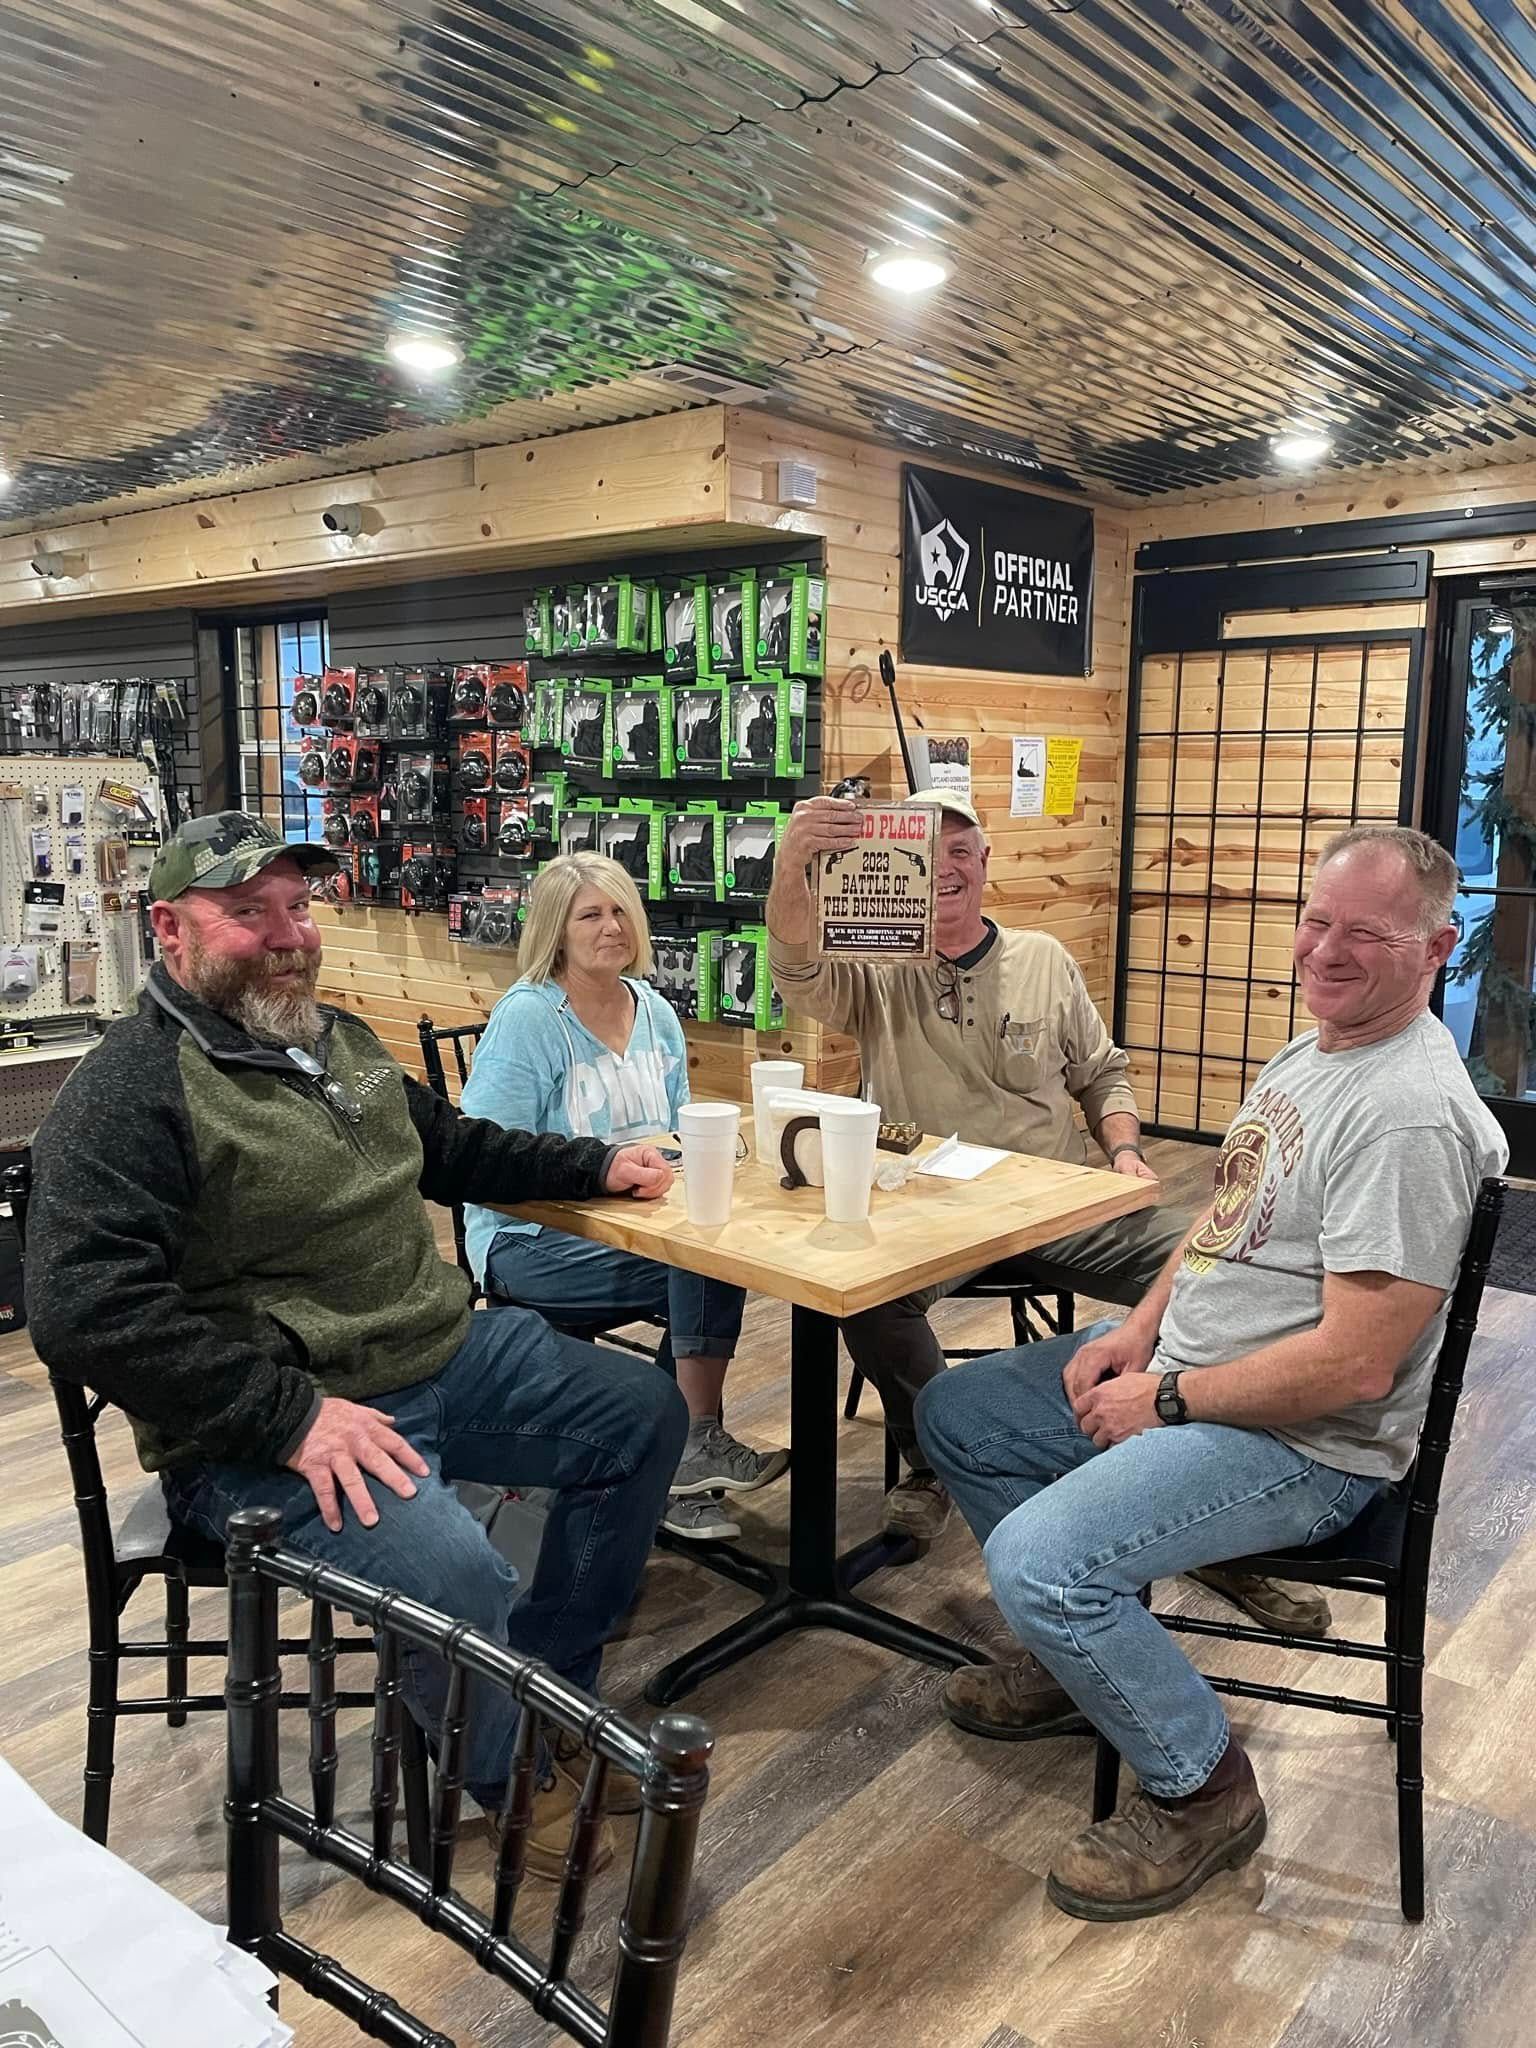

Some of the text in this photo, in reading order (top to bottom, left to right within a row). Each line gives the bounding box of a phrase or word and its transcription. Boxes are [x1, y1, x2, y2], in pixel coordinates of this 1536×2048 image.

[994, 551, 1074, 592] OFFICIAL
[916, 584, 969, 611] USCCA
[993, 585, 1078, 625] PARTNER
[880, 815, 926, 840] PLACE
[862, 852, 890, 872] 2023
[842, 874, 910, 895] BATTLE OF
[824, 897, 926, 919] THE BUSINESSES
[698, 944, 706, 963] PACK
[1252, 1087, 1304, 1178] MARINES
